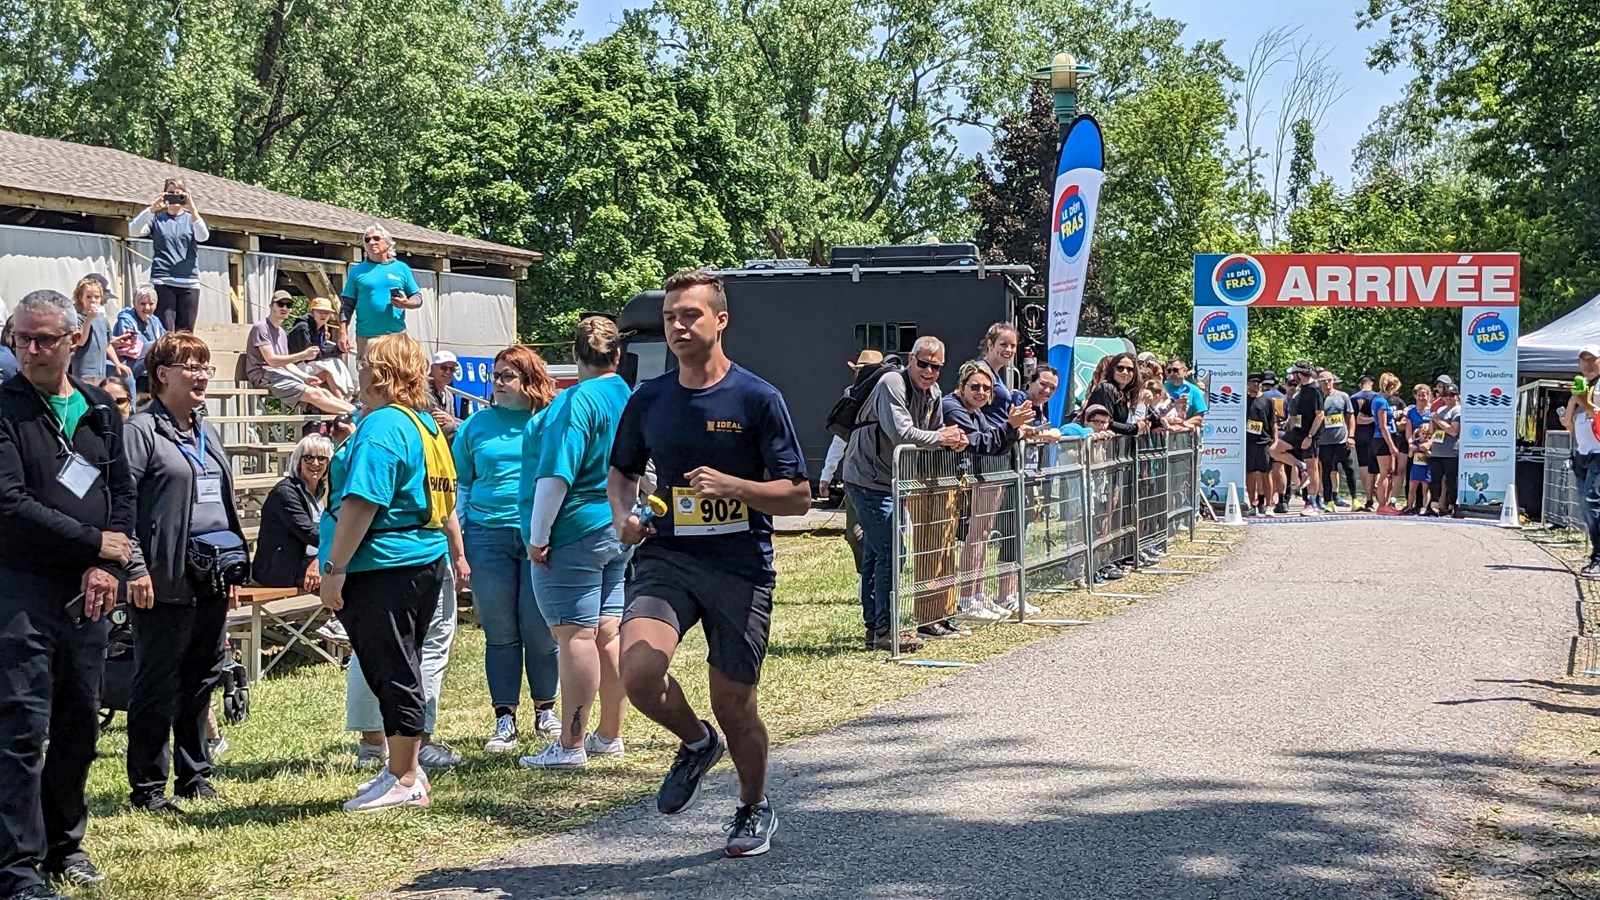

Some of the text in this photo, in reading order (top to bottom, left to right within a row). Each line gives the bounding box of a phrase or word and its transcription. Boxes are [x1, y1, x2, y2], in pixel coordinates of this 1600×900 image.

[1062, 209, 1068, 221] LE
[1061, 212, 1084, 241] FRAS
[1225, 276, 1255, 290] FRAS
[1276, 255, 1515, 302] ARRIVÉE
[1206, 330, 1235, 343] FRAS
[1476, 330, 1506, 344] FRAS
[1209, 369, 1243, 378] Desjardins
[1477, 371, 1513, 379] Desjardins
[716, 421, 743, 429] IDEAL
[1202, 447, 1227, 456] etro
[1464, 450, 1497, 459] metro
[700, 498, 743, 523] 902
